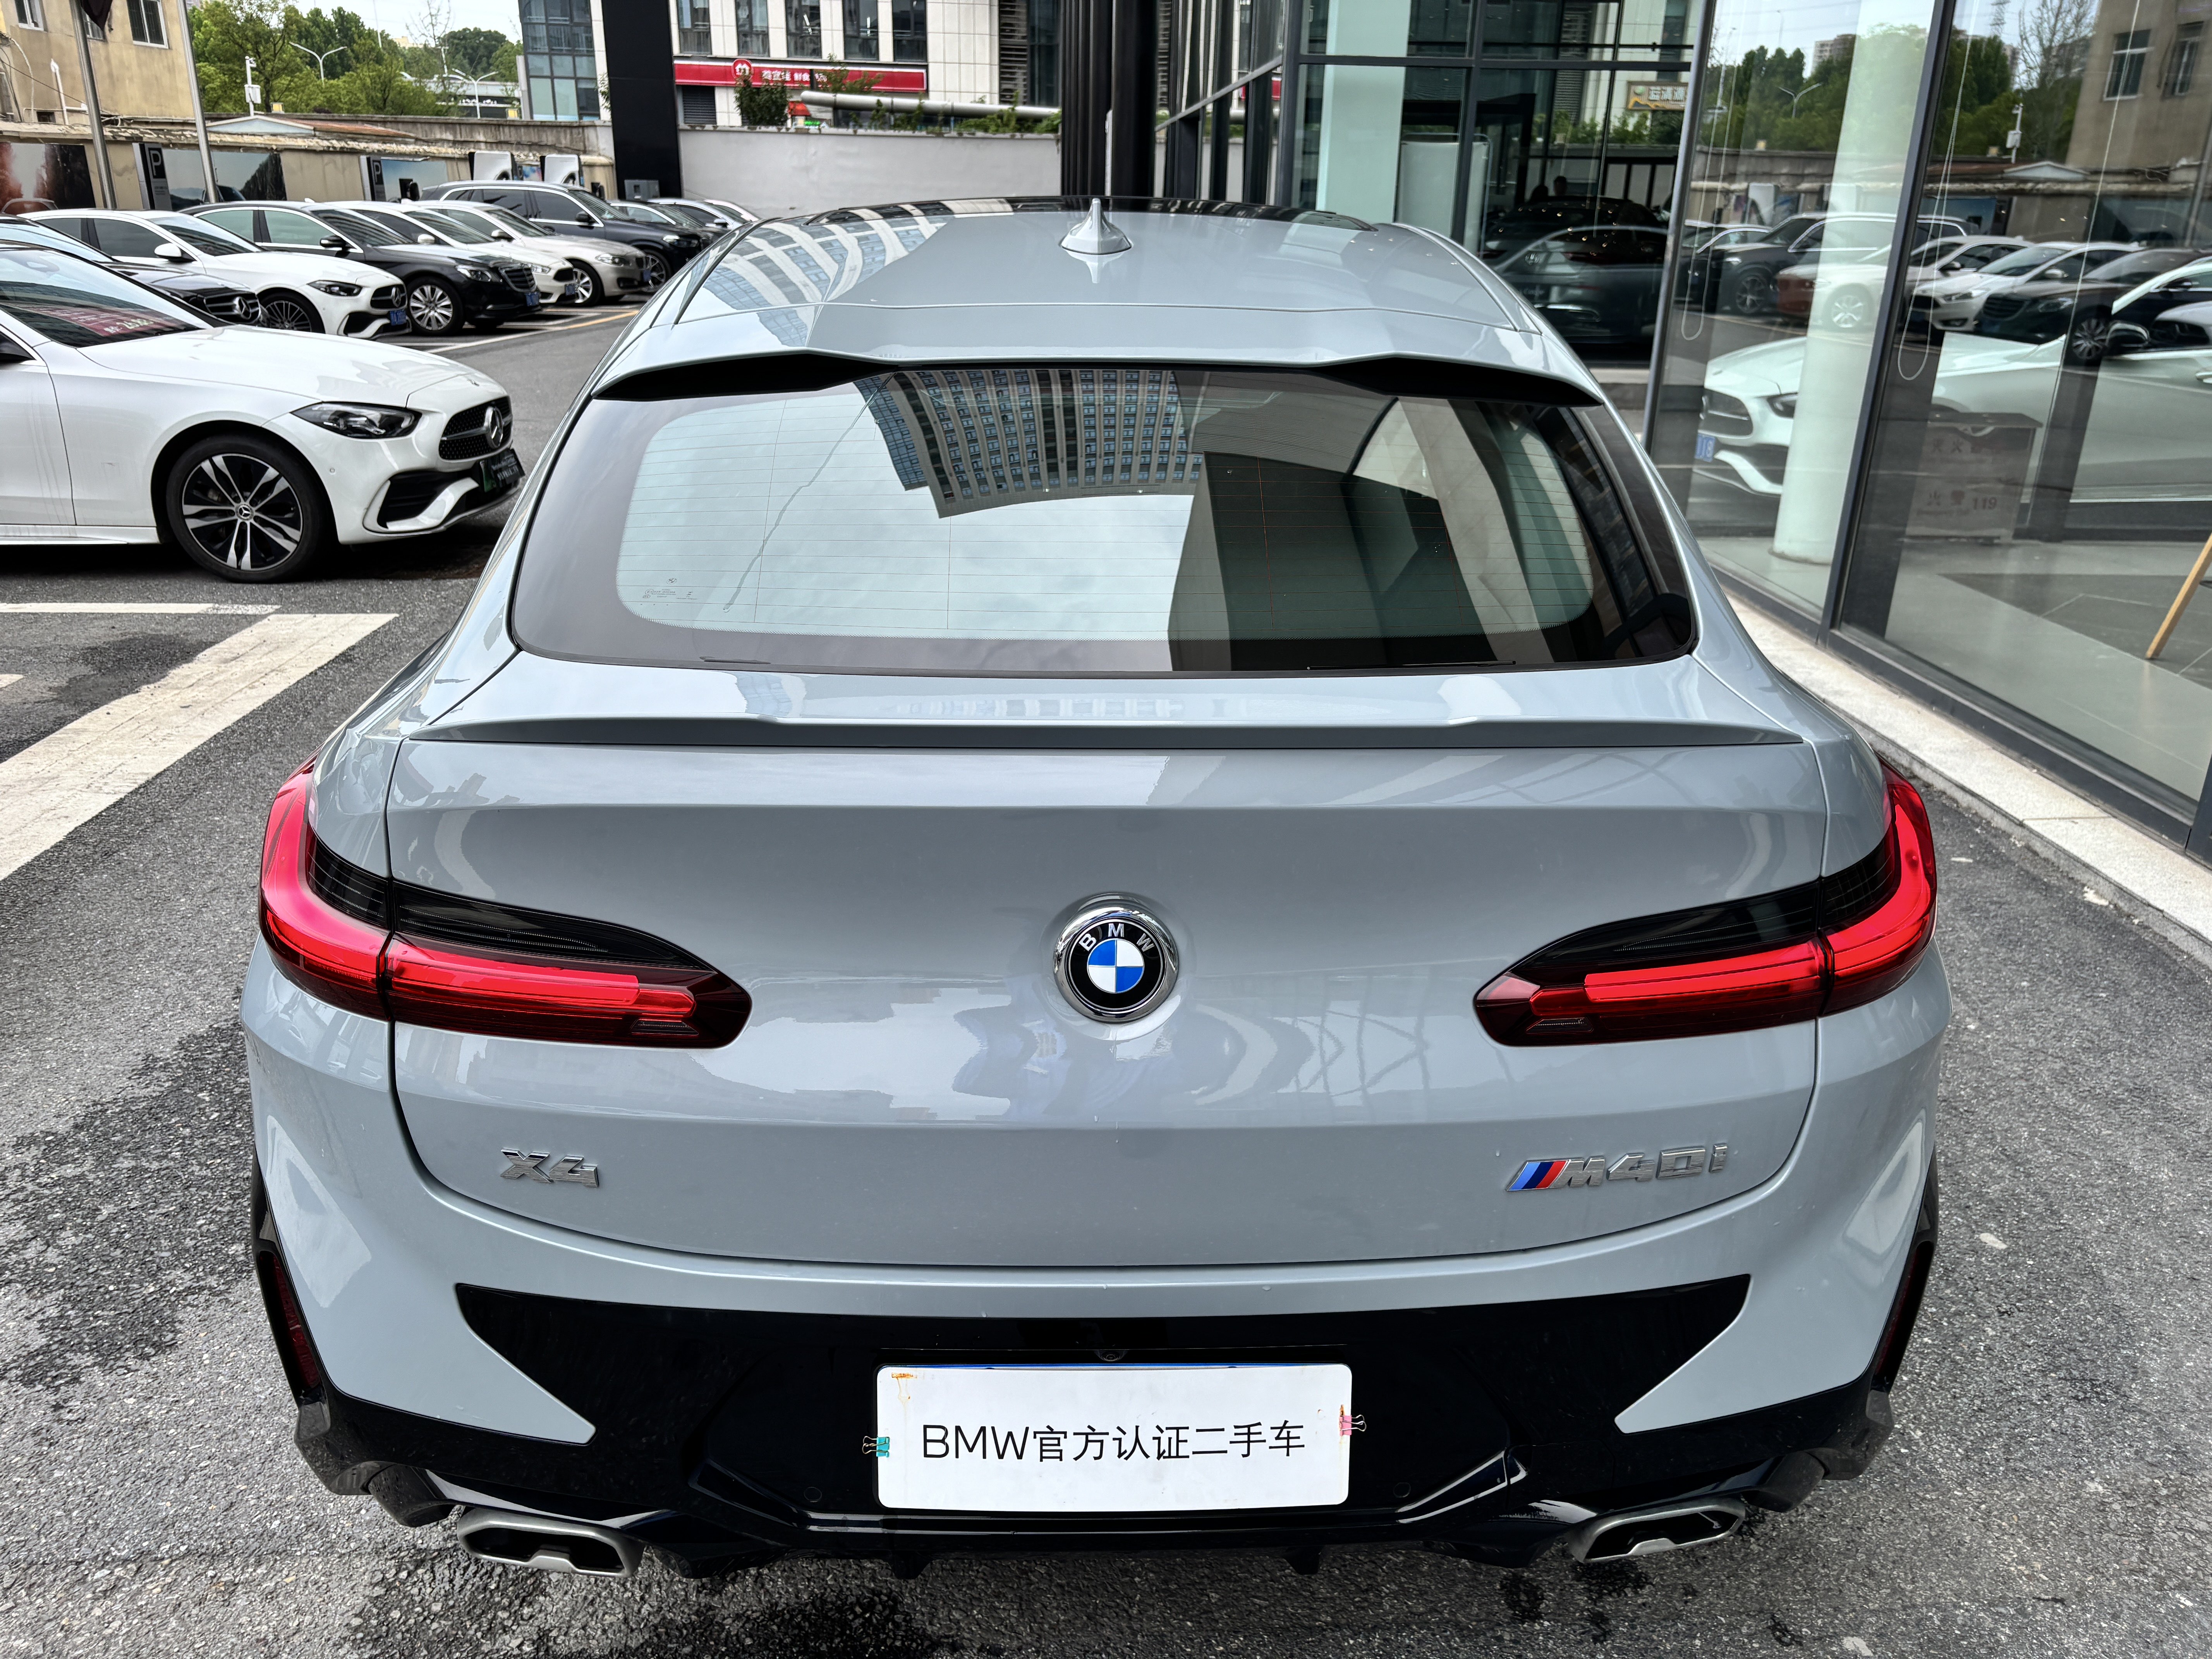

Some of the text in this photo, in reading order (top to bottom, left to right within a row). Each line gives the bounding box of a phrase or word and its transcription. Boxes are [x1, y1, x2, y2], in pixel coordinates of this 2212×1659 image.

[150, 150, 161, 176] P
[373, 162, 381, 182] P
[1972, 496, 1997, 510] 119
[1079, 923, 1155, 952] BMW
[500, 1147, 599, 1188] X4
[1548, 1142, 1728, 1188] M40i
[922, 1420, 1306, 1463] BMW官方认证二手车
